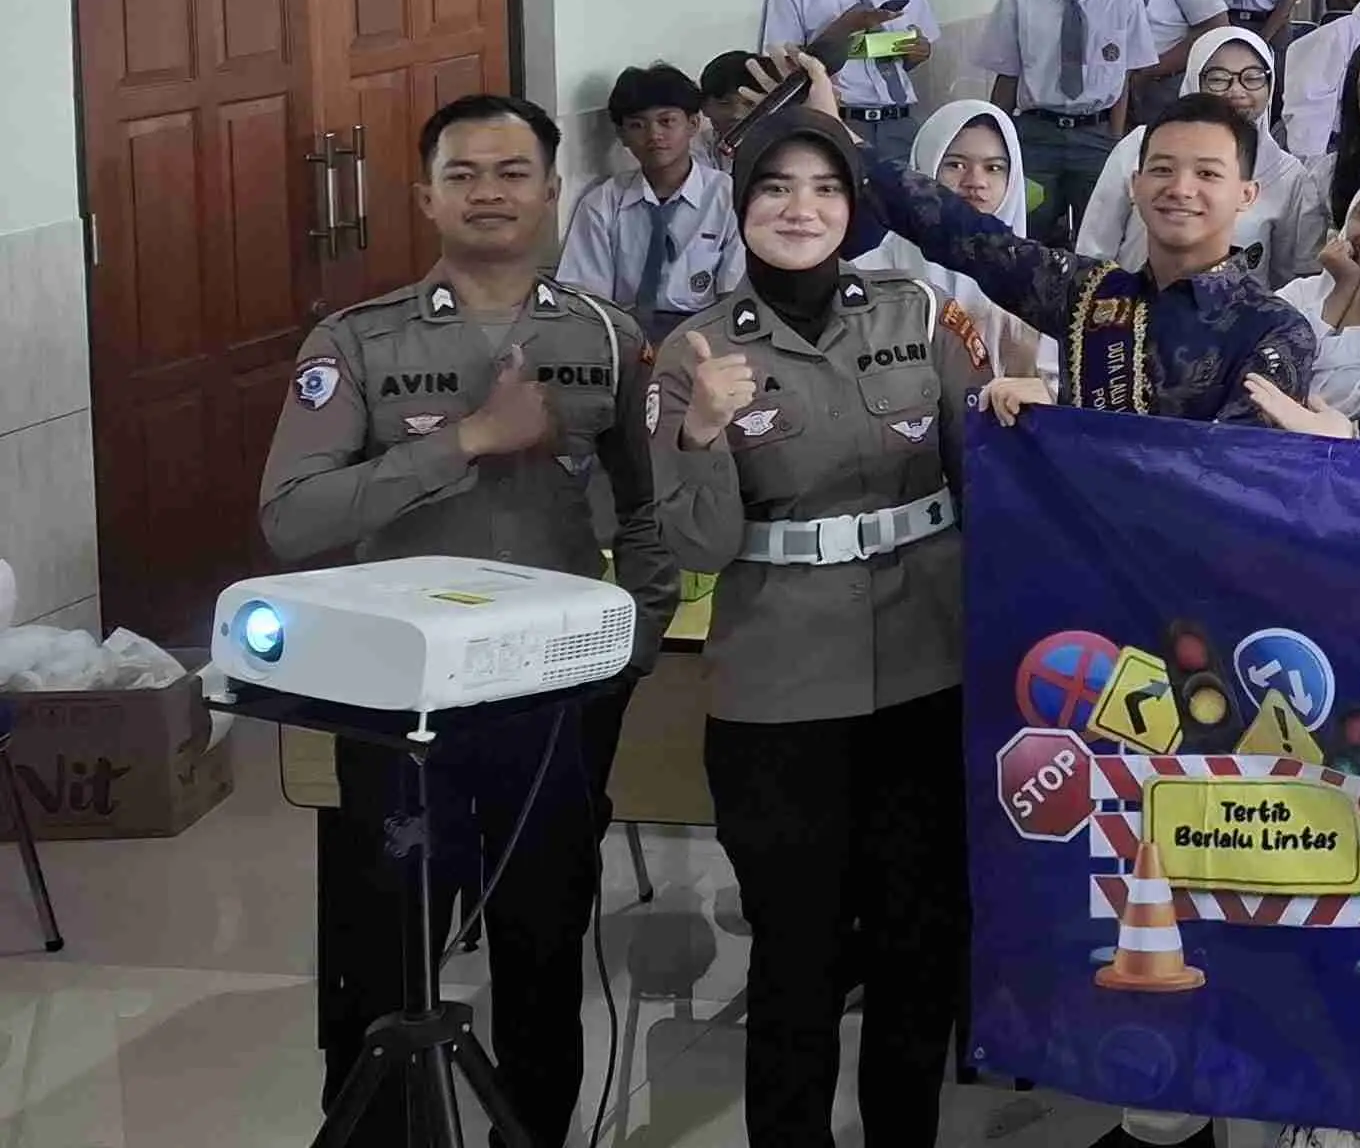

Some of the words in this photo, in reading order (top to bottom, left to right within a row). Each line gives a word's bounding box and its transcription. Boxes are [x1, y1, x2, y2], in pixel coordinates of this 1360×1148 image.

[856, 344, 927, 372] POLRI
[380, 372, 458, 396] AVIN
[537, 365, 610, 387] POLRI
[1012, 749, 1075, 818] STOP
[1221, 800, 1291, 823] Tertib
[1174, 826, 1253, 850] Berlalu
[1260, 826, 1339, 851] Lintas
